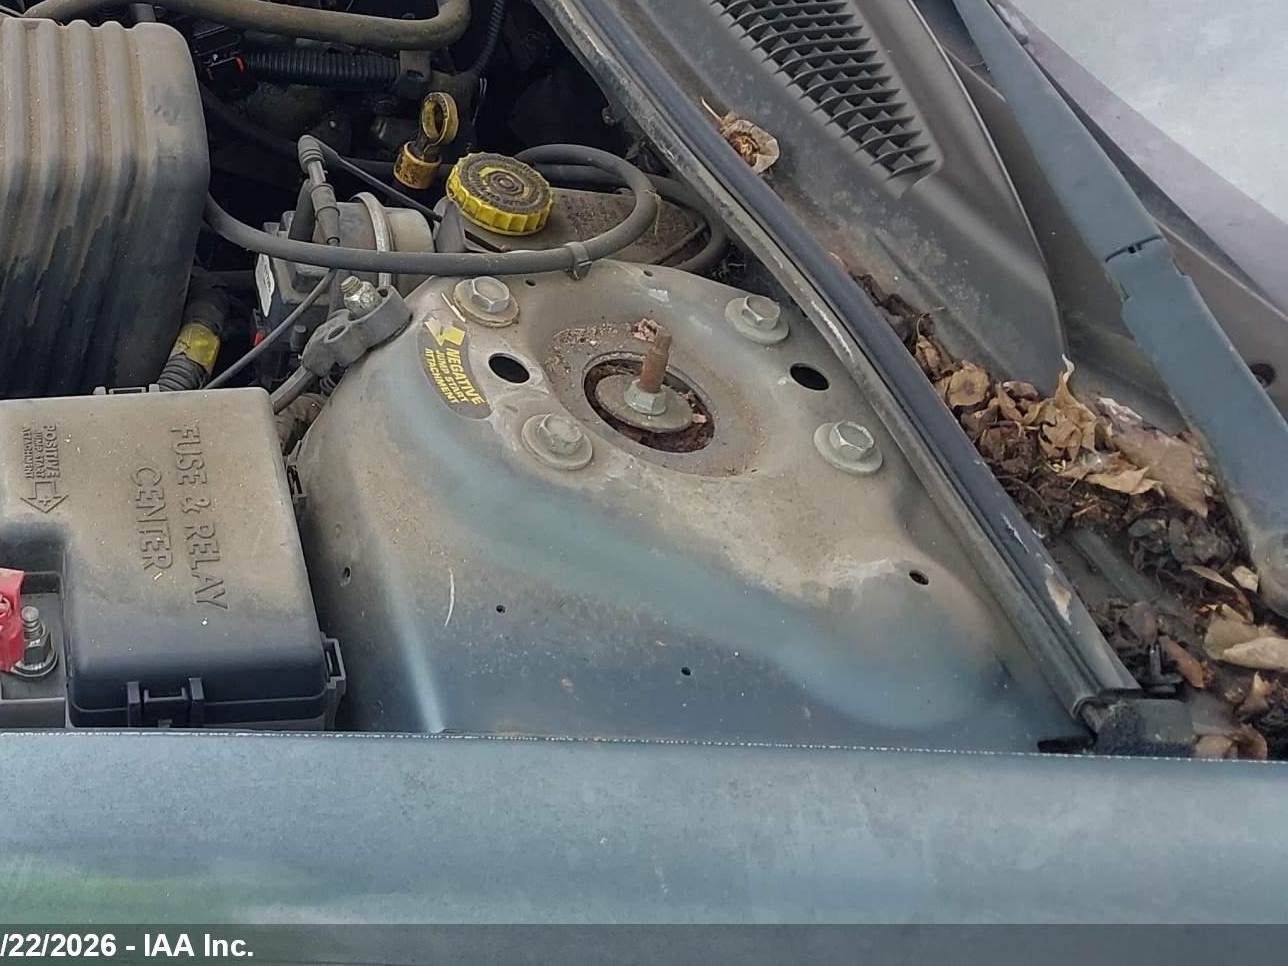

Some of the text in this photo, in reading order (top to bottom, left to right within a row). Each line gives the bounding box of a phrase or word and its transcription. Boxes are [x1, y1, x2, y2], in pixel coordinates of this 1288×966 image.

[424, 347, 460, 404] ATTACHMENT
[434, 349, 469, 403] JUMP START
[445, 348, 487, 405] NEGATIVE
[43, 424, 60, 478] POSITIVE
[130, 466, 174, 571] CENTER
[170, 424, 229, 610] FUSE & RELAY
